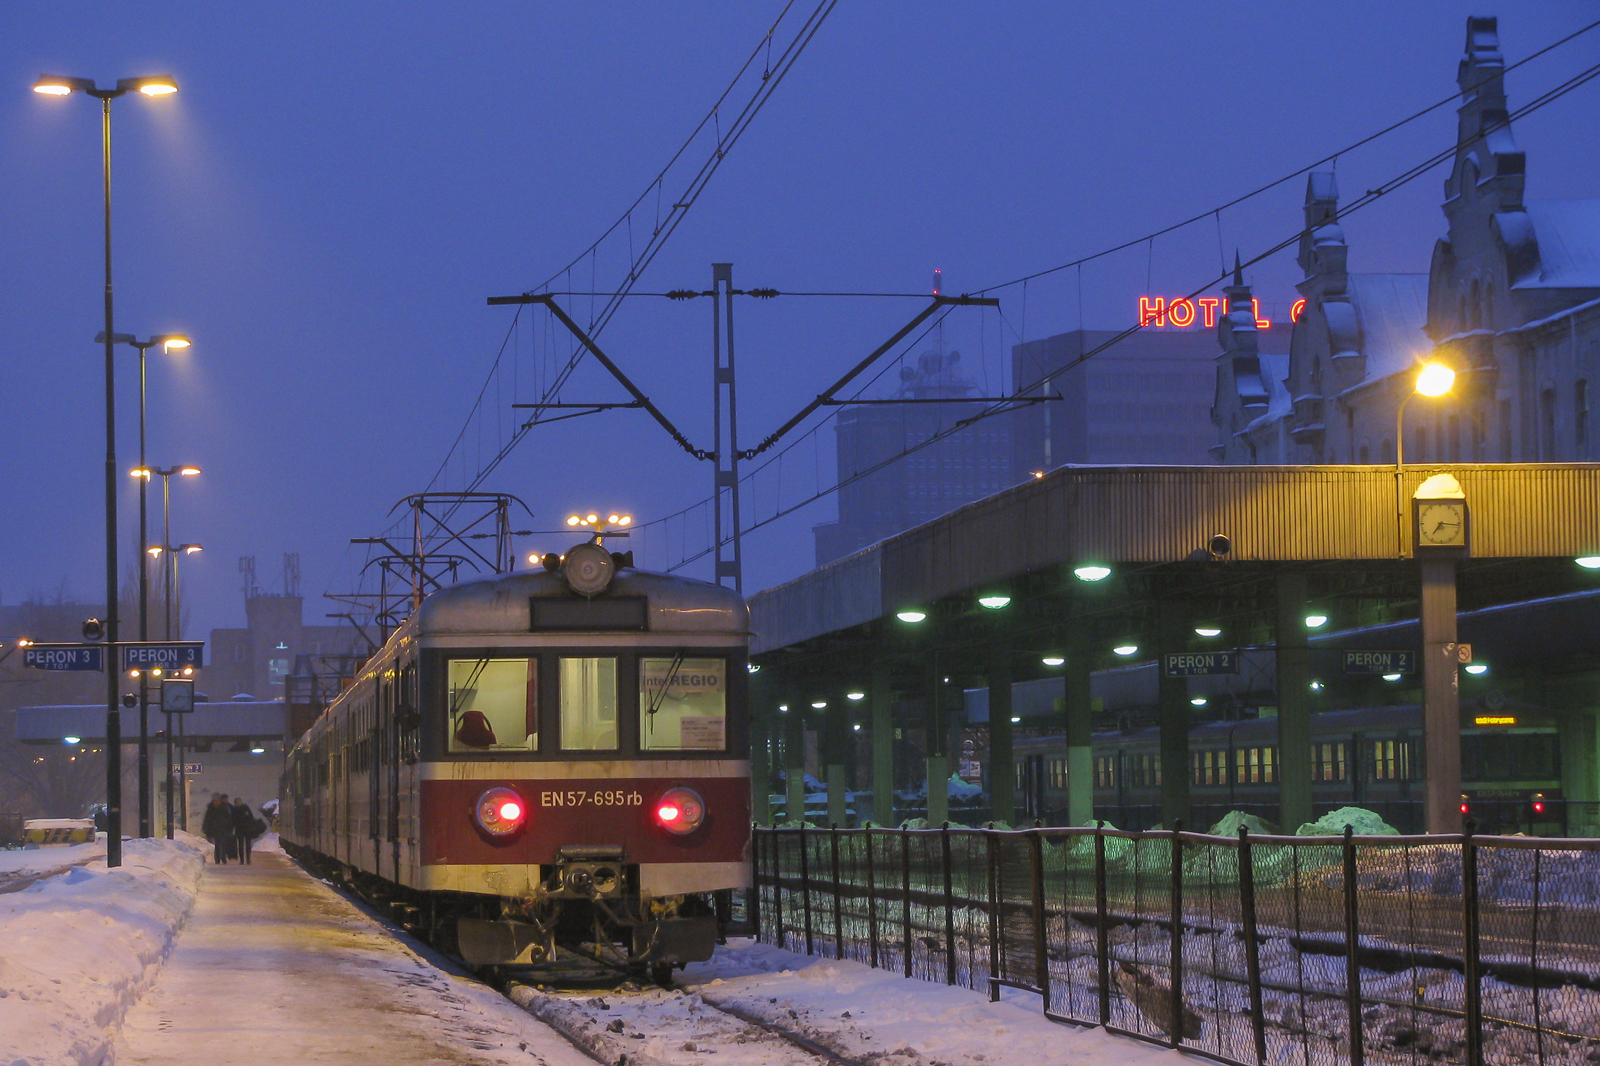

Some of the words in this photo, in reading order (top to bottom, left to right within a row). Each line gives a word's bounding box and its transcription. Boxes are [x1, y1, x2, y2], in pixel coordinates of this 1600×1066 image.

[1139, 297, 1270, 328] HOTL
[26, 650, 77, 664] PERON
[83, 651, 91, 663] 3
[129, 648, 178, 662] PERON
[187, 648, 195, 661] 3
[1169, 655, 1214, 669] PERON
[1221, 654, 1229, 667] 2
[1347, 653, 1392, 666] PERON
[1398, 653, 1406, 666] 2
[1193, 667, 1208, 675] TOR
[541, 790, 643, 807] EN57-695rb
